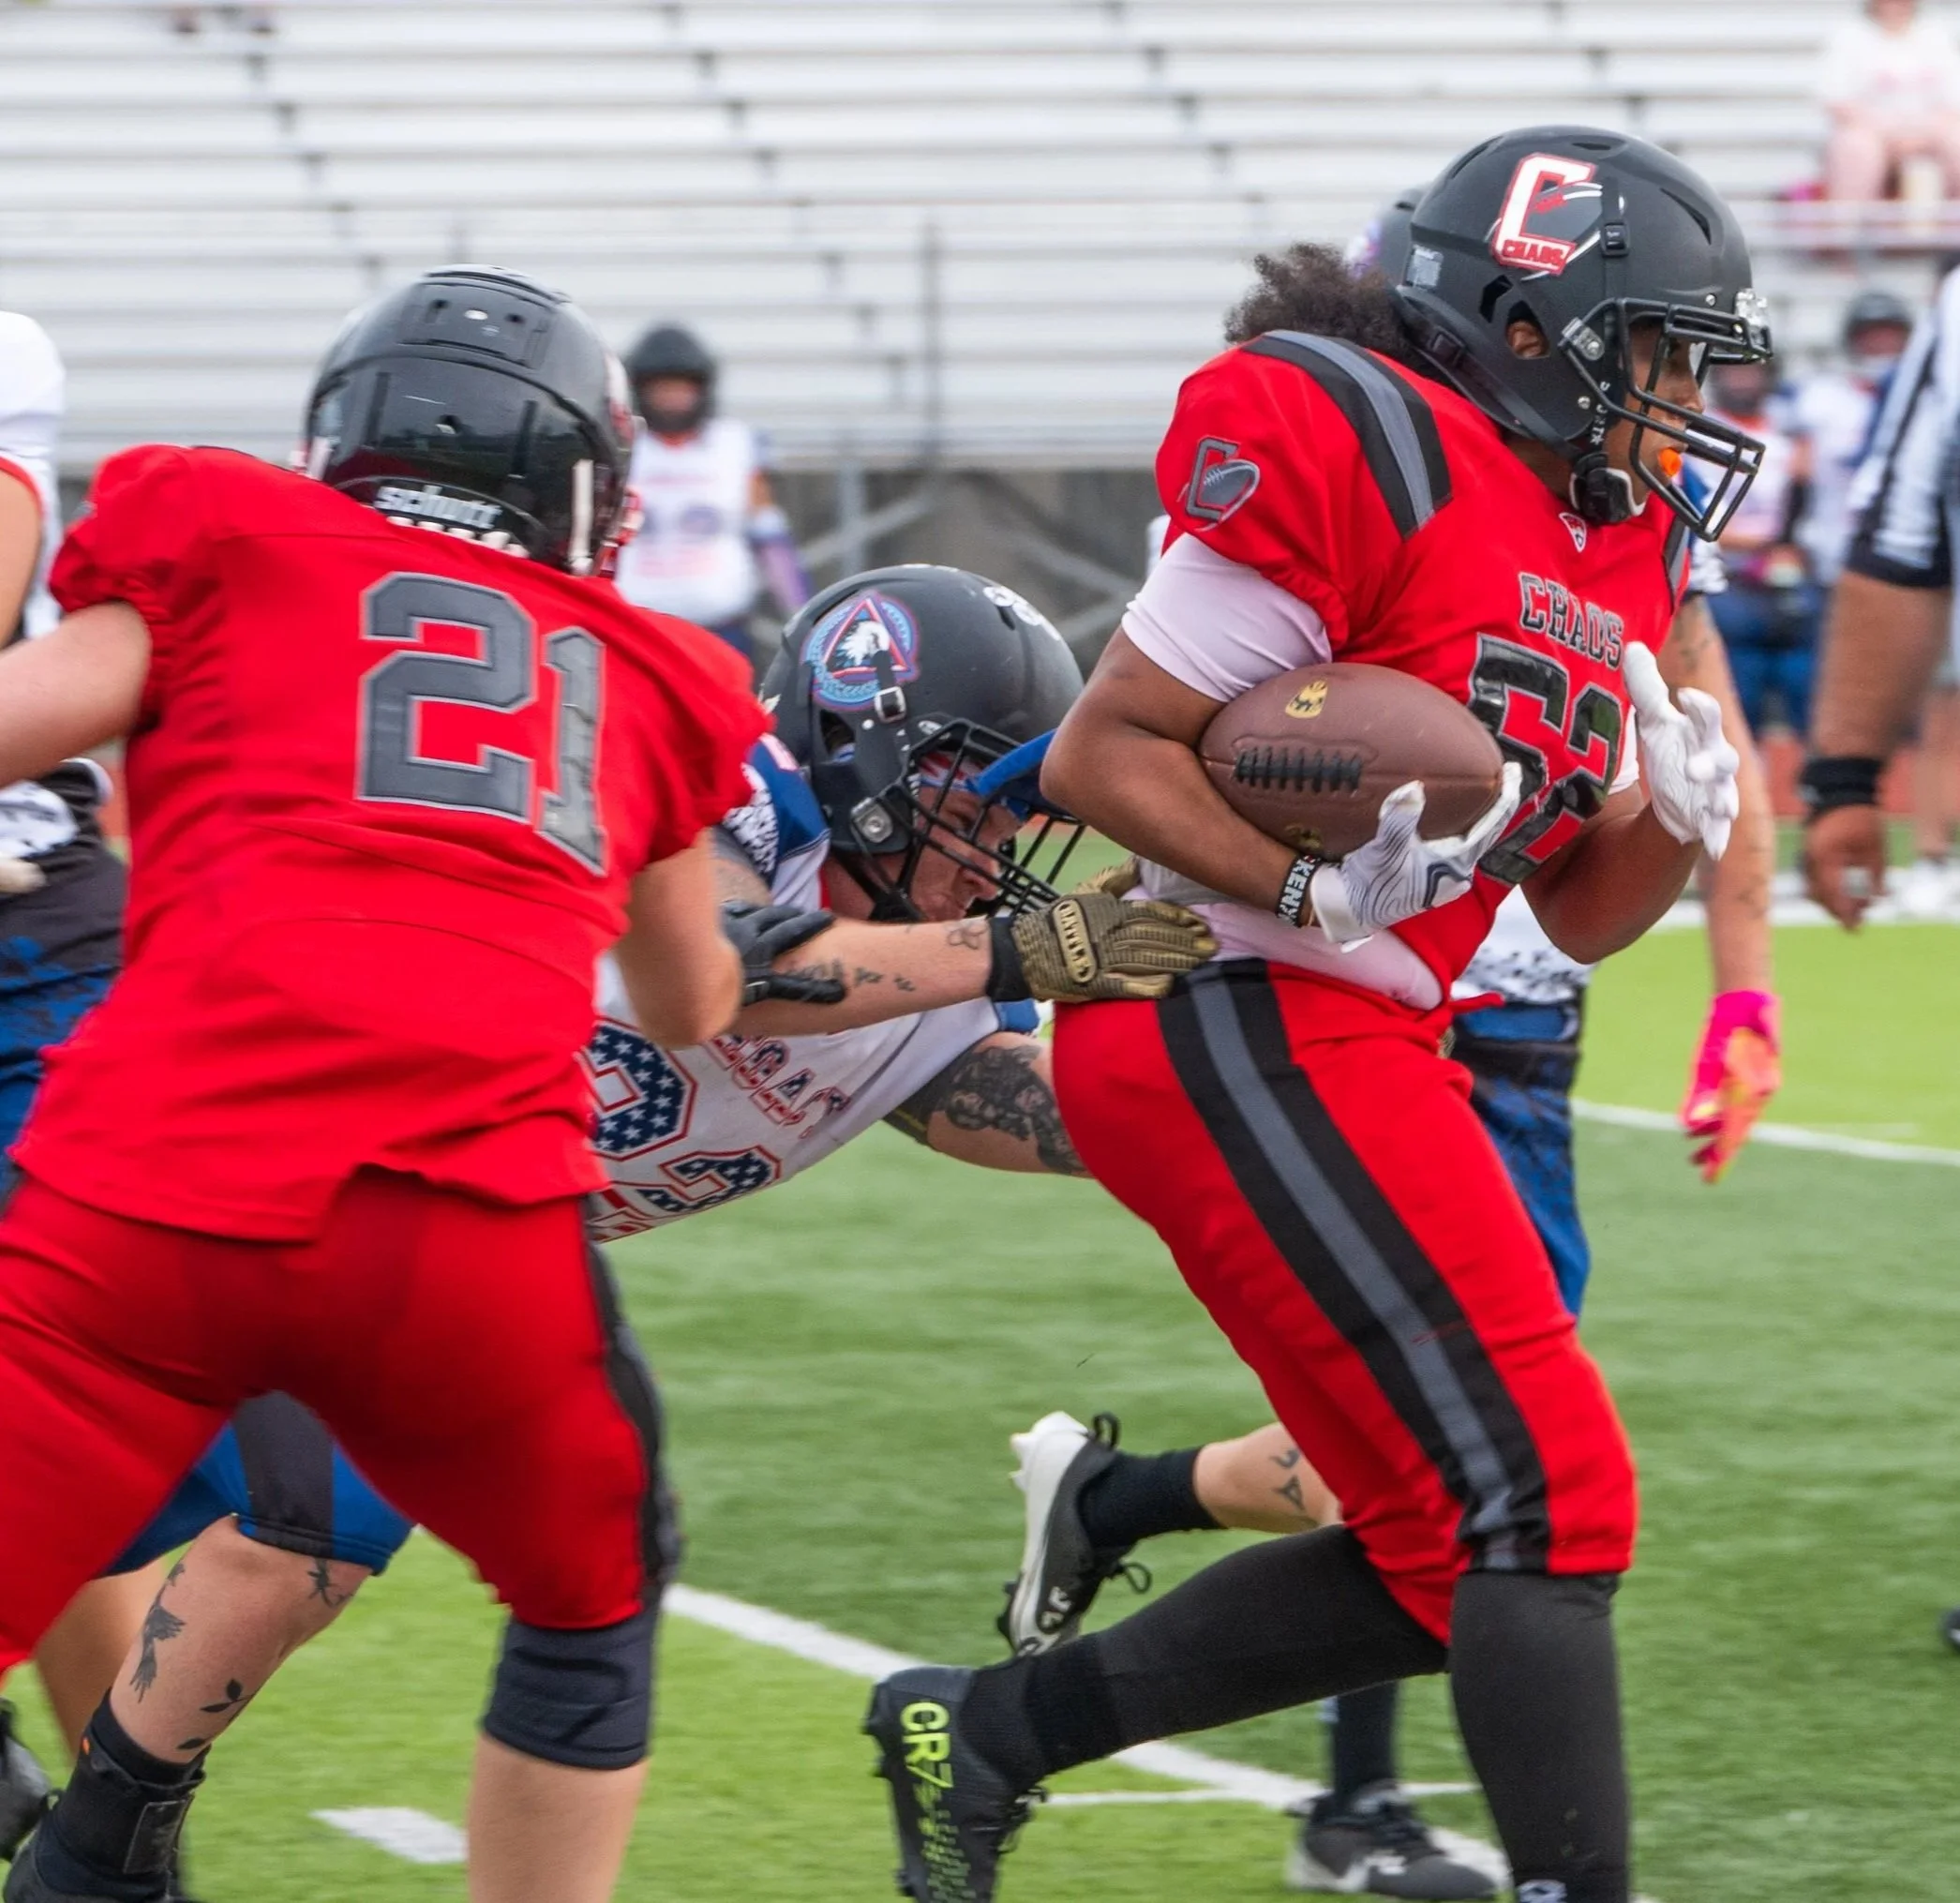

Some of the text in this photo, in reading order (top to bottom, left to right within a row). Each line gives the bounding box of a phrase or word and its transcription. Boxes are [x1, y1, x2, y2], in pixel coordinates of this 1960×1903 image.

[1518, 572, 1623, 670] CHAOS
[354, 571, 609, 877] 21
[900, 1701, 954, 1789] CR7
